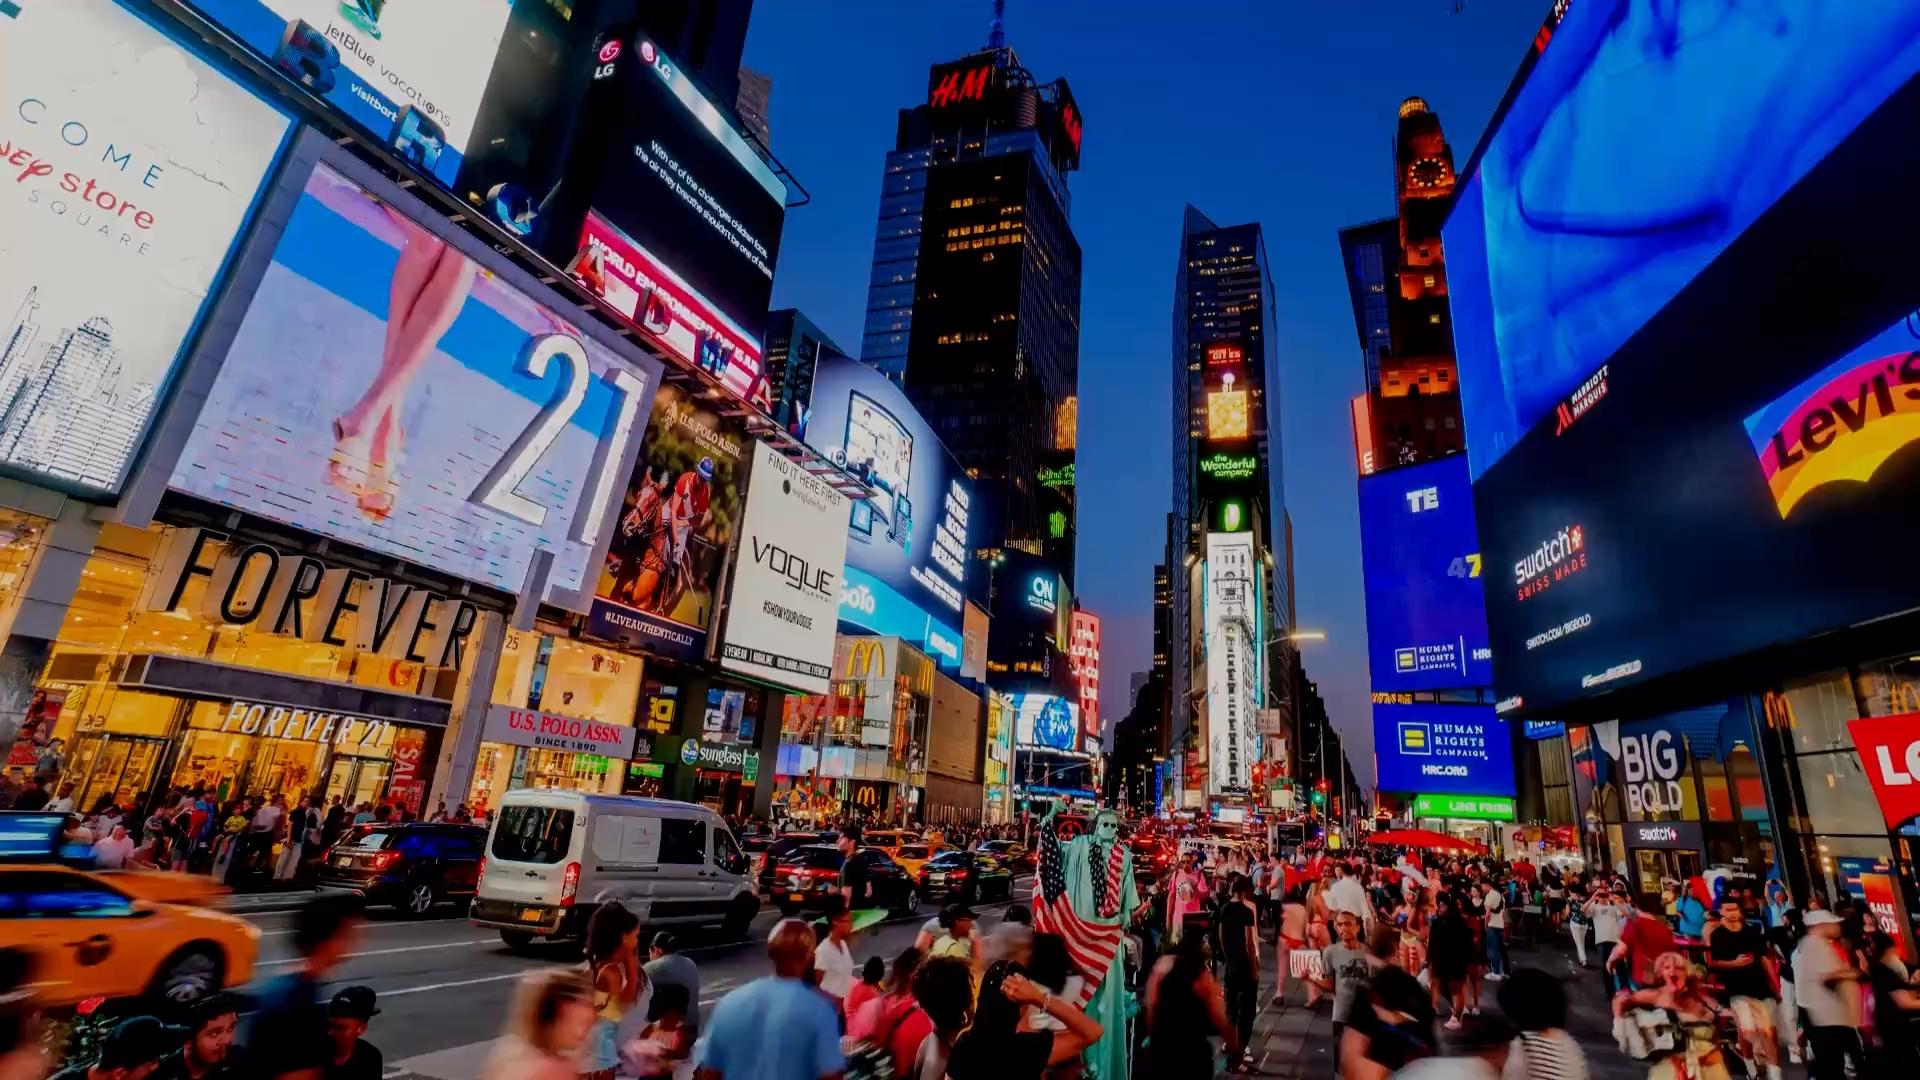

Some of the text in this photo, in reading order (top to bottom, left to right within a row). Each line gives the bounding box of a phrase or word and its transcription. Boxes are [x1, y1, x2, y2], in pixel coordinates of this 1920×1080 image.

[325, 20, 451, 127] jetBlue vacations
[594, 64, 615, 80] LG
[654, 56, 672, 80] LG
[931, 66, 991, 108] H&M
[635, 146, 649, 163] the
[660, 168, 676, 189] they
[652, 140, 668, 163] With
[678, 169, 687, 179] of
[686, 175, 698, 190] the
[698, 188, 731, 222] challenges
[60, 172, 154, 229] store
[28, 190, 151, 256] SQUARE
[1571, 364, 1609, 405] MARRIOTT
[1572, 380, 1608, 418] MARQUIS
[474, 332, 644, 546] 21
[680, 413, 740, 458] U.S. POLO ASSN.
[1201, 457, 1256, 471] Wonderful
[1214, 468, 1249, 478] company
[1215, 454, 1228, 462] the
[768, 453, 841, 507] FIND IT HERE FIRST
[1406, 486, 1439, 513] TE
[1515, 526, 1573, 585] swatch
[1517, 553, 1588, 601] SWISS MADE
[165, 527, 478, 672] FOREVER
[505, 635, 519, 650] 25
[604, 611, 694, 646] #LIVEAUTHENTICALLY
[1526, 613, 1592, 650] SWATCH.COM/BIGBOLD
[1419, 644, 1454, 654] HUMAN
[1419, 653, 1455, 663] RIGHTS
[1420, 662, 1455, 670] CAMPAIGN
[221, 700, 391, 748] FOREVER 21
[509, 711, 622, 745] U.S. POLO ASSN.
[1434, 723, 1483, 735] HUMAN
[534, 735, 596, 752] SINCE 1890
[700, 746, 742, 767] sunglass
[1435, 736, 1485, 748] RIGHTS
[1436, 748, 1486, 758] CAMPAIGN
[1621, 729, 1679, 783] BIG
[1422, 764, 1468, 776] HRC.ORG
[1627, 782, 1683, 813] BOLD
[1639, 827, 1670, 842] swatch
